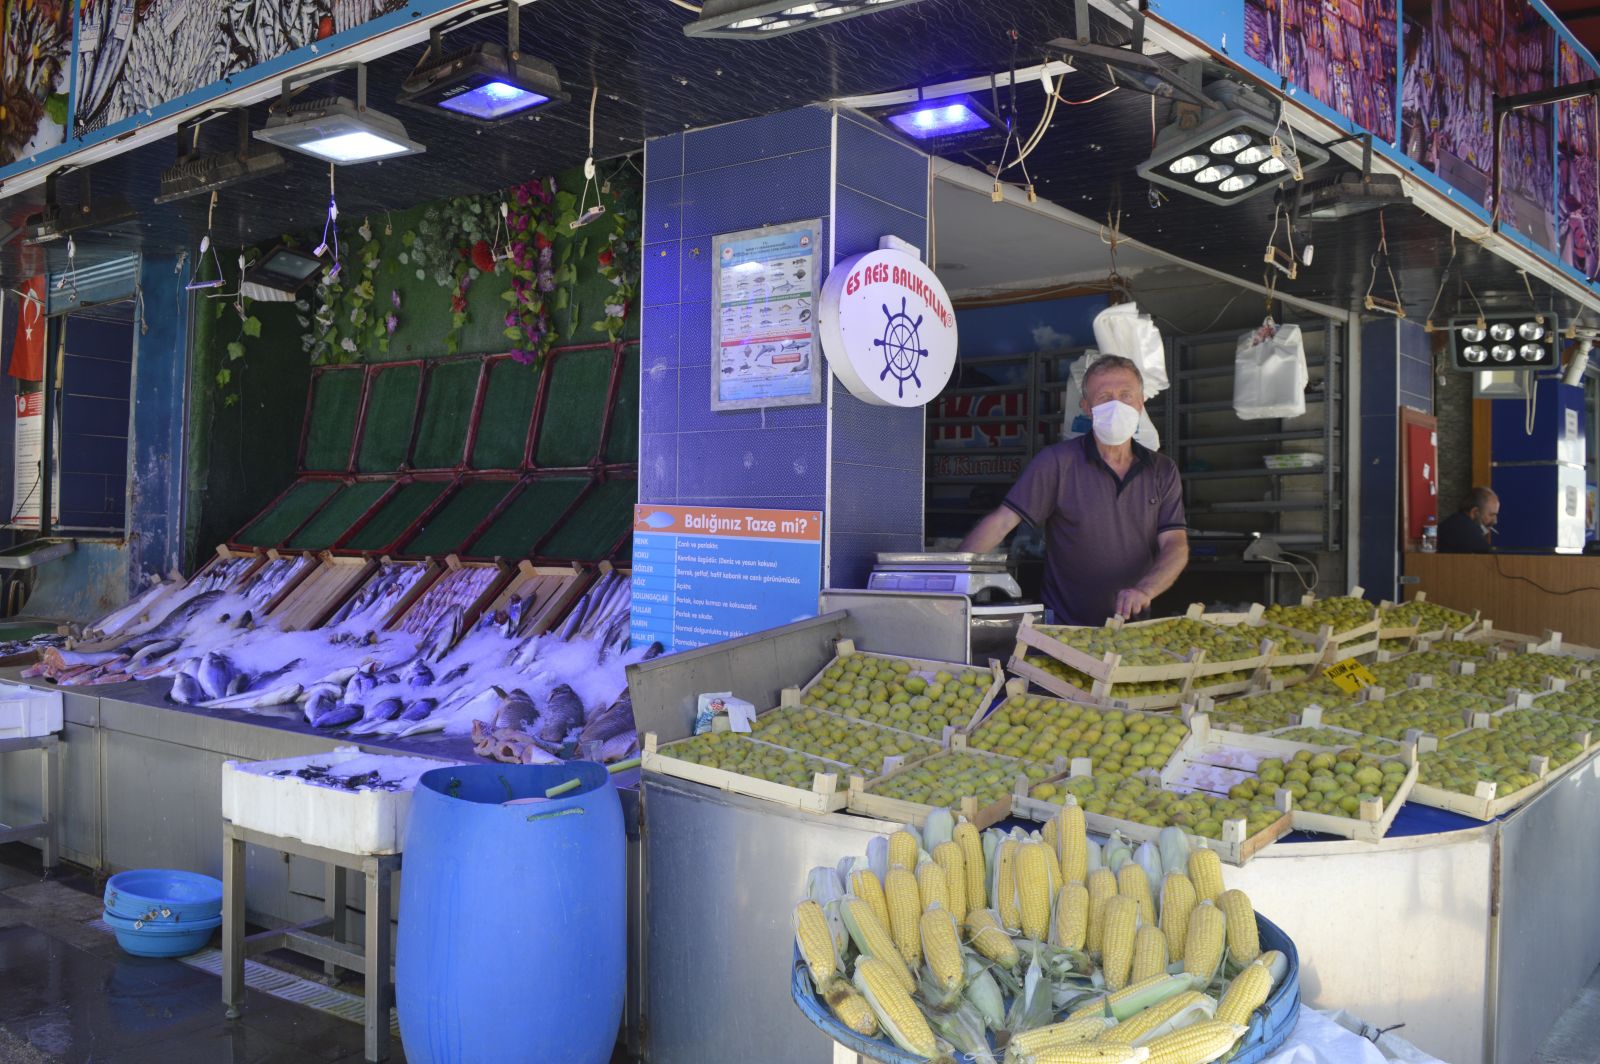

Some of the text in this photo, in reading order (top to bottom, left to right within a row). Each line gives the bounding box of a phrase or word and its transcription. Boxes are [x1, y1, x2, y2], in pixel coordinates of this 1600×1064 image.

[847, 270, 861, 296] ES
[892, 265, 948, 329] BALIKÇILIK
[684, 513, 808, 534] Balığınız Taze mi?
[634, 537, 649, 545] RENK
[634, 551, 649, 559] KOKU
[633, 564, 654, 573] GÖZLER
[632, 592, 669, 602] SOLUNGAÇLAR
[1345, 672, 1361, 688] 7
